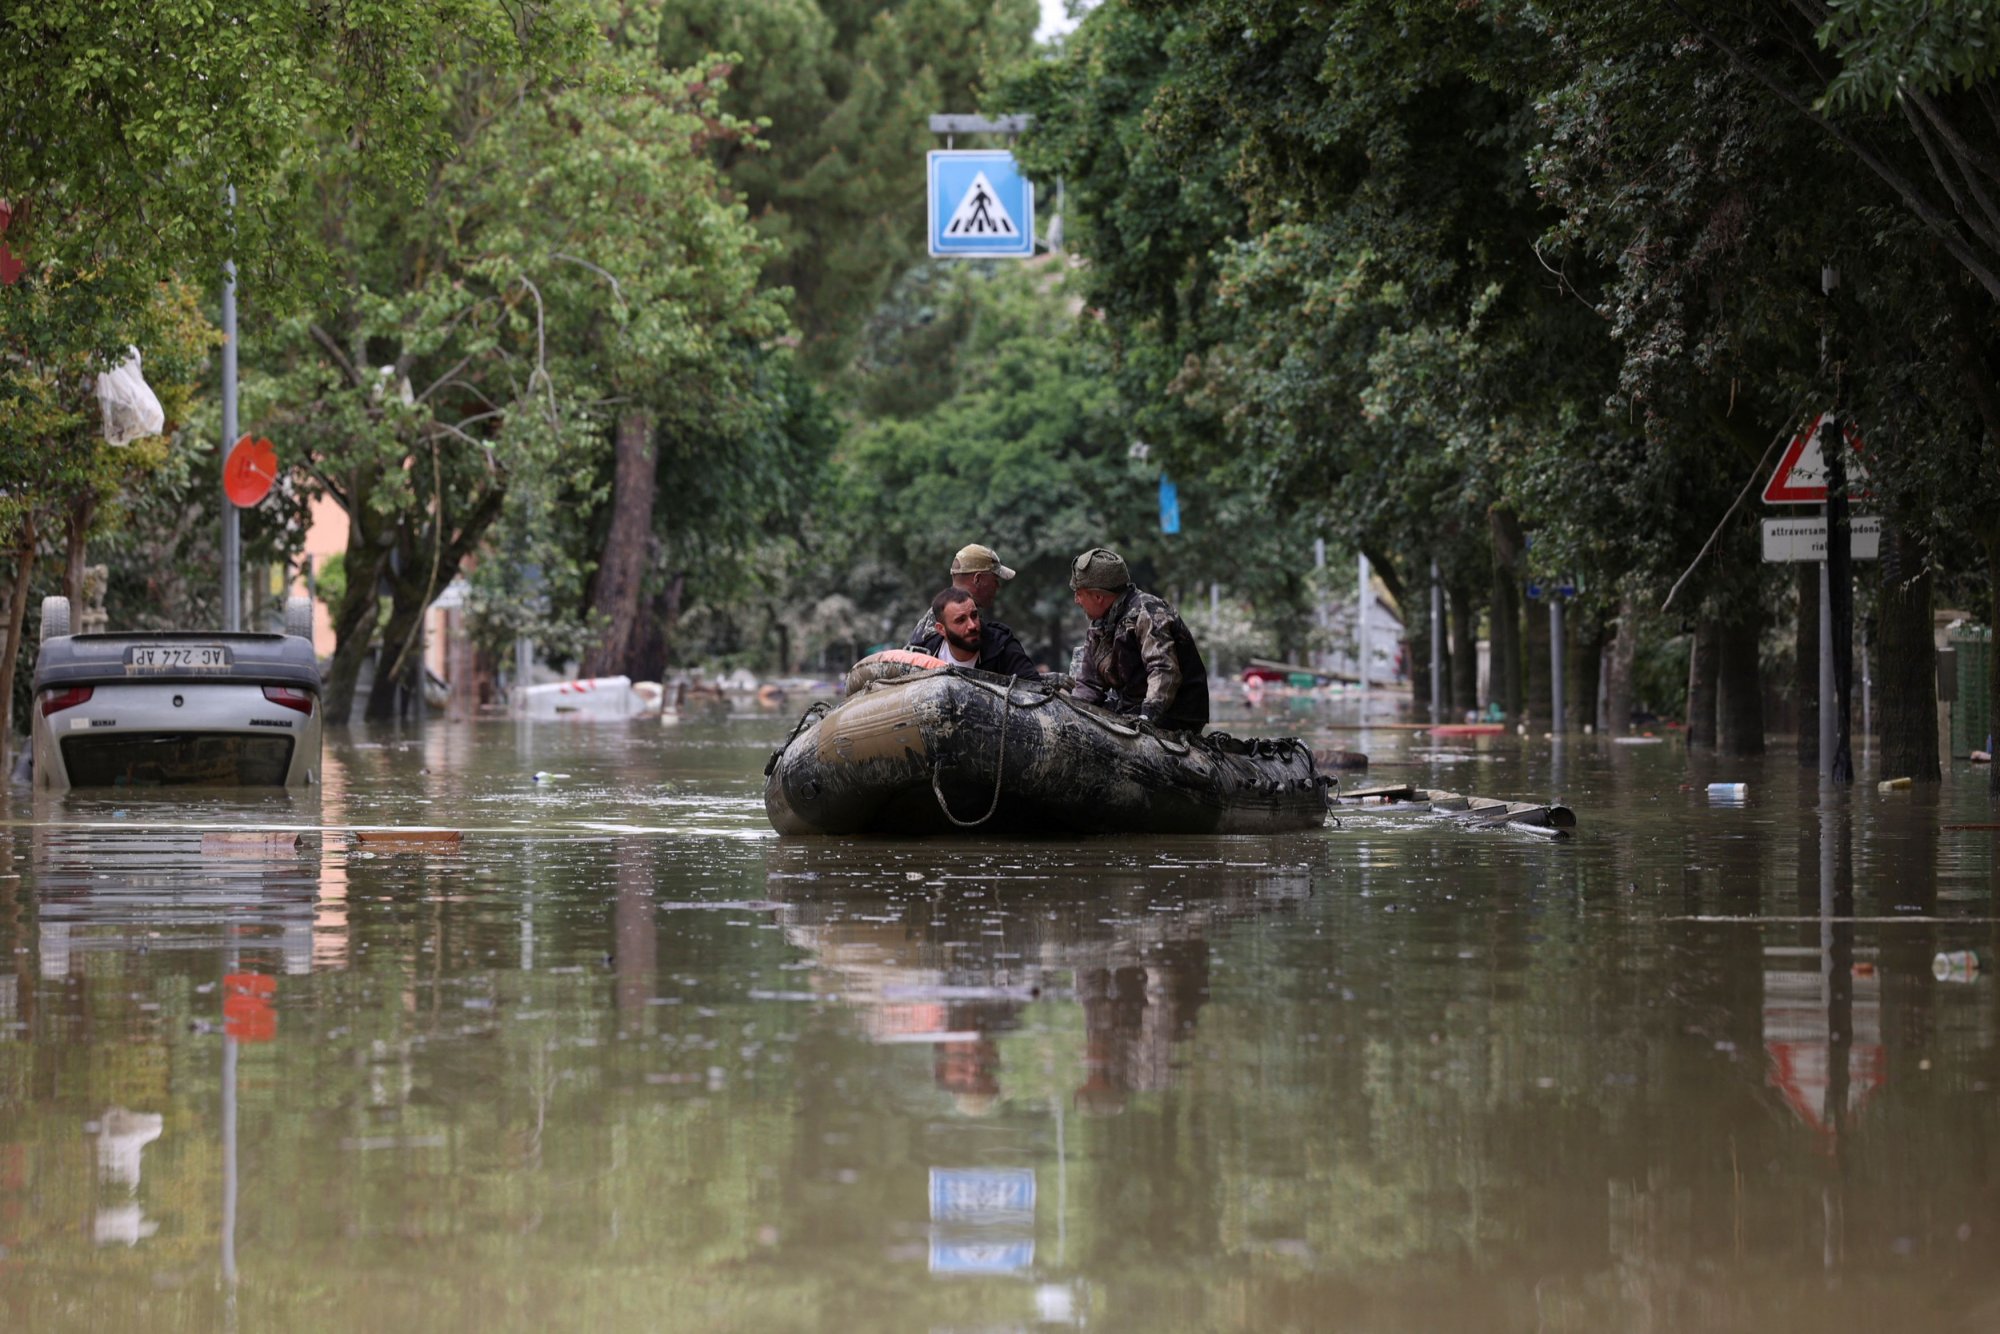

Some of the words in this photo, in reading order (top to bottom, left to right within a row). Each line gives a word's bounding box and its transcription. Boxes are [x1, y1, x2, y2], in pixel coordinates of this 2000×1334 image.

[1771, 527, 1827, 537] attraversam
[136, 650, 155, 665] AP
[162, 650, 192, 667] 244
